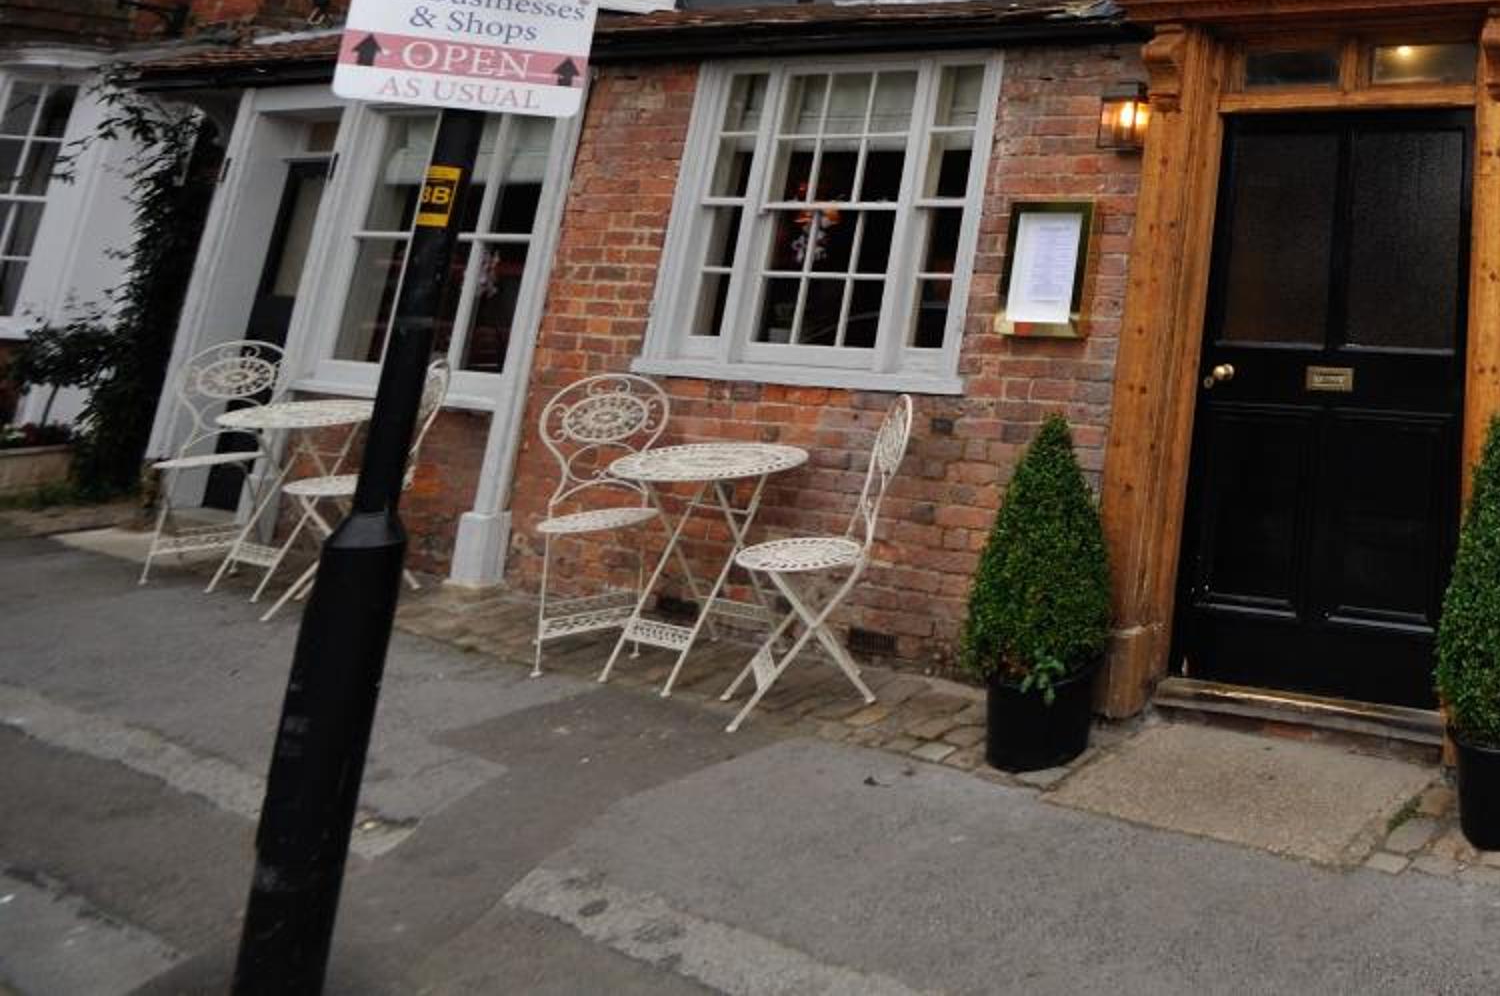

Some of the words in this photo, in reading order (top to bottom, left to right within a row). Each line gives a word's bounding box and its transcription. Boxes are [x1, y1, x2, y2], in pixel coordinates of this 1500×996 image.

[409, 5, 437, 29] &
[447, 10, 538, 45] Shops
[402, 40, 532, 79] OPEN
[379, 75, 421, 98] AS
[433, 77, 540, 110] USUAL
